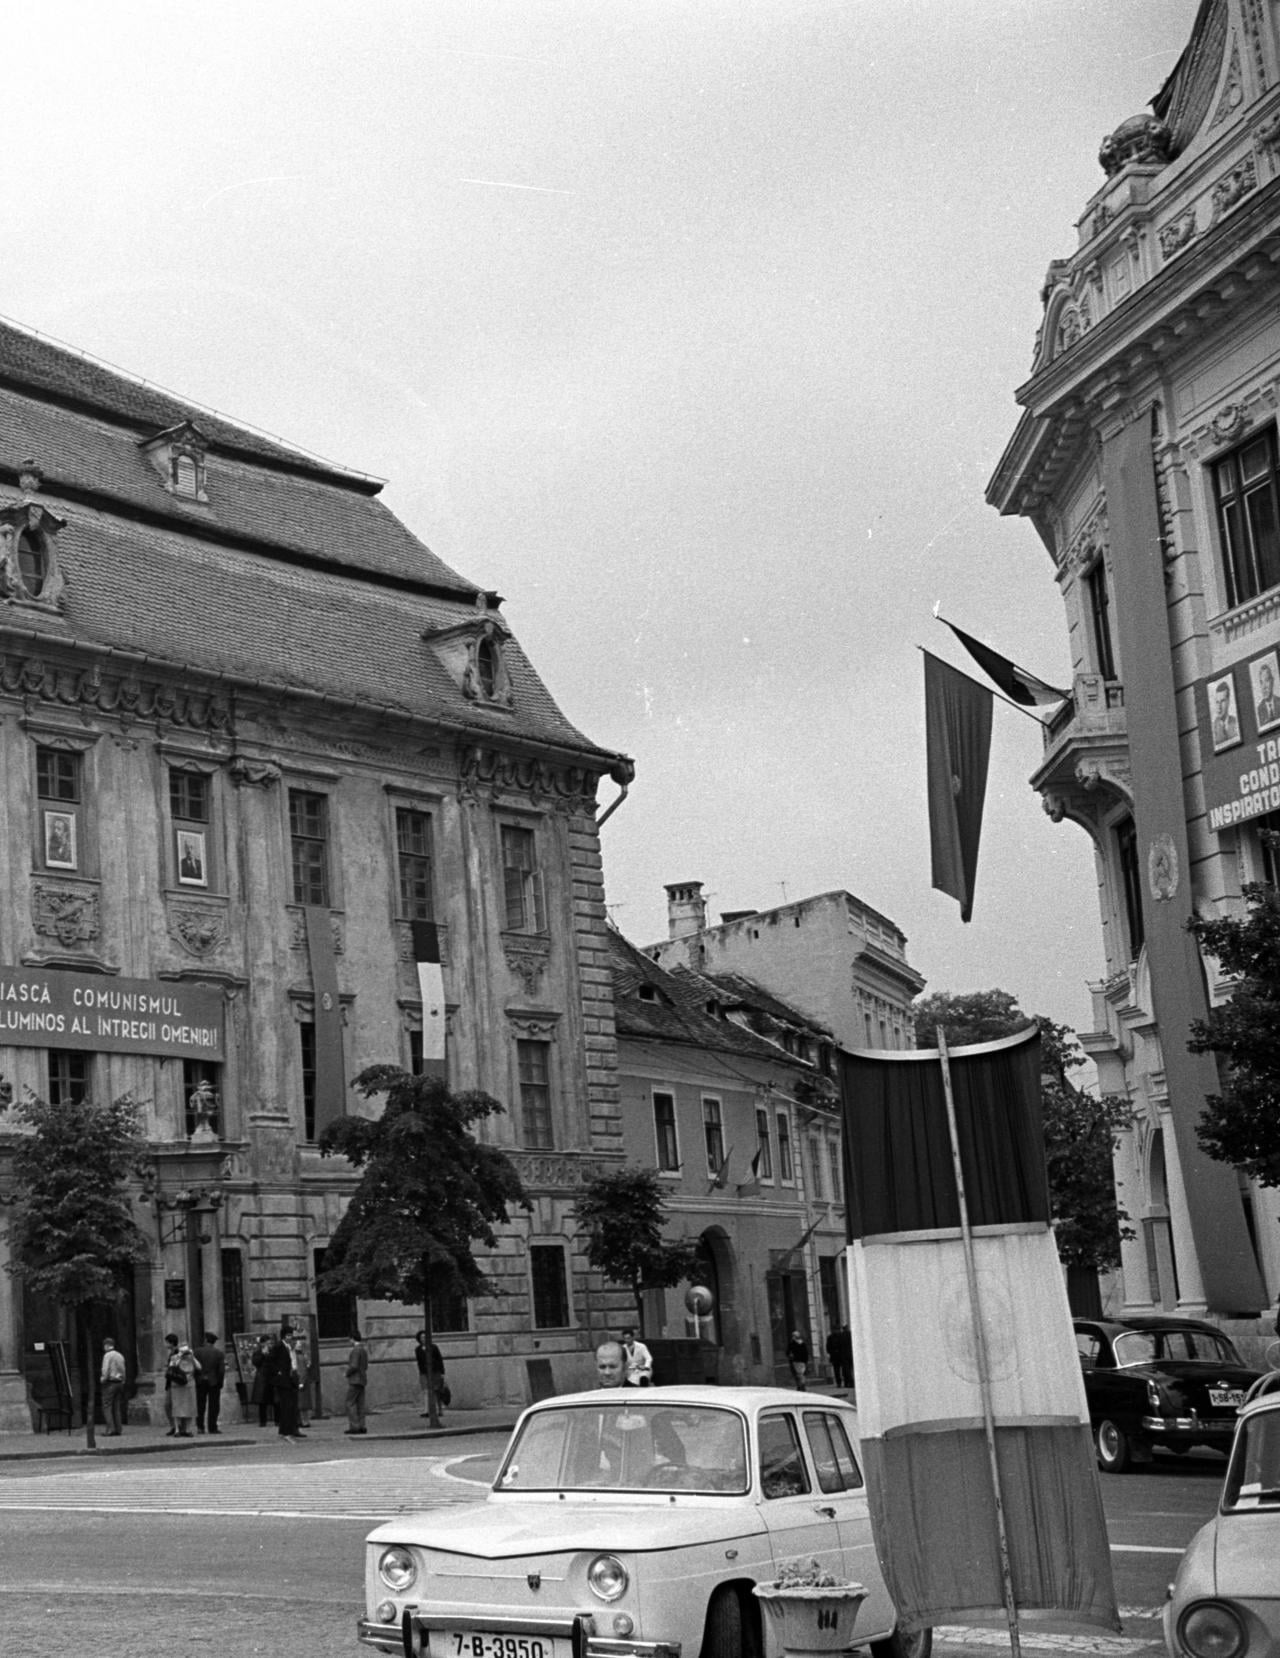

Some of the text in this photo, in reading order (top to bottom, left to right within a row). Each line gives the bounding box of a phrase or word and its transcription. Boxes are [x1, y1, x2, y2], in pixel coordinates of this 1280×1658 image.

[1256, 737, 1280, 764] TR
[1209, 785, 1280, 829] INSPIRATO
[73, 987, 182, 1017] COMUNISMUL
[71, 1015, 91, 1035] AL
[161, 1024, 218, 1050] OMENIRI!
[453, 1633, 543, 1658] 7-B-3950
